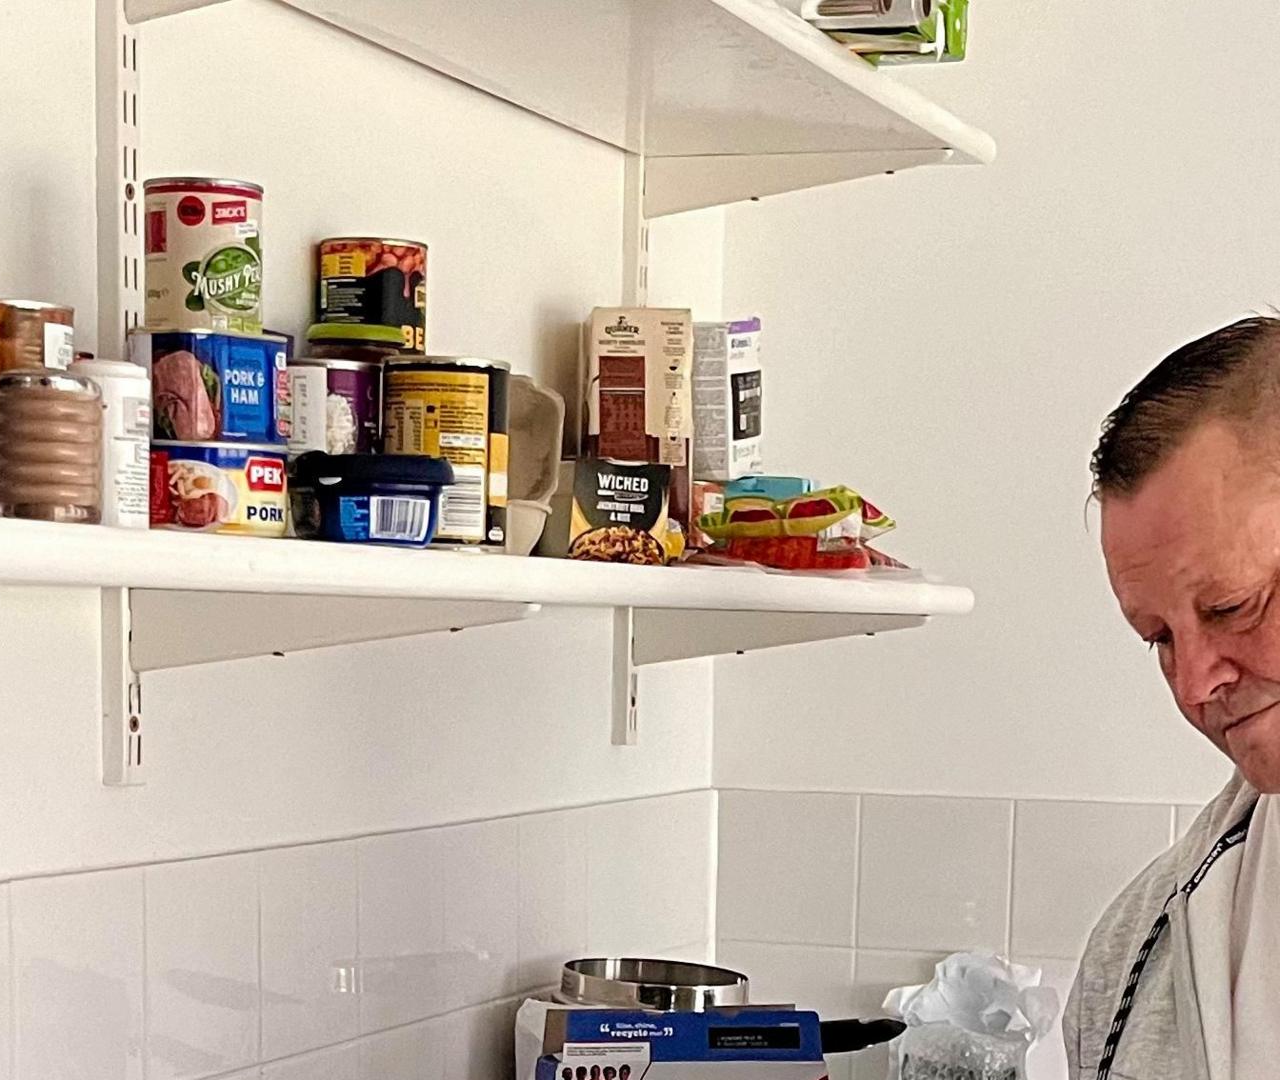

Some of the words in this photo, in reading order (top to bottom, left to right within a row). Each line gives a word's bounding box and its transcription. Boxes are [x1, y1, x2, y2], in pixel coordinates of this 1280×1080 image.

[192, 270, 241, 300] MUSHY
[224, 369, 254, 387] PORK
[257, 374, 265, 387] &
[230, 388, 260, 405] HAM
[250, 465, 282, 486] PEK
[246, 505, 284, 523] PORK
[610, 1029, 648, 1039] recycle
